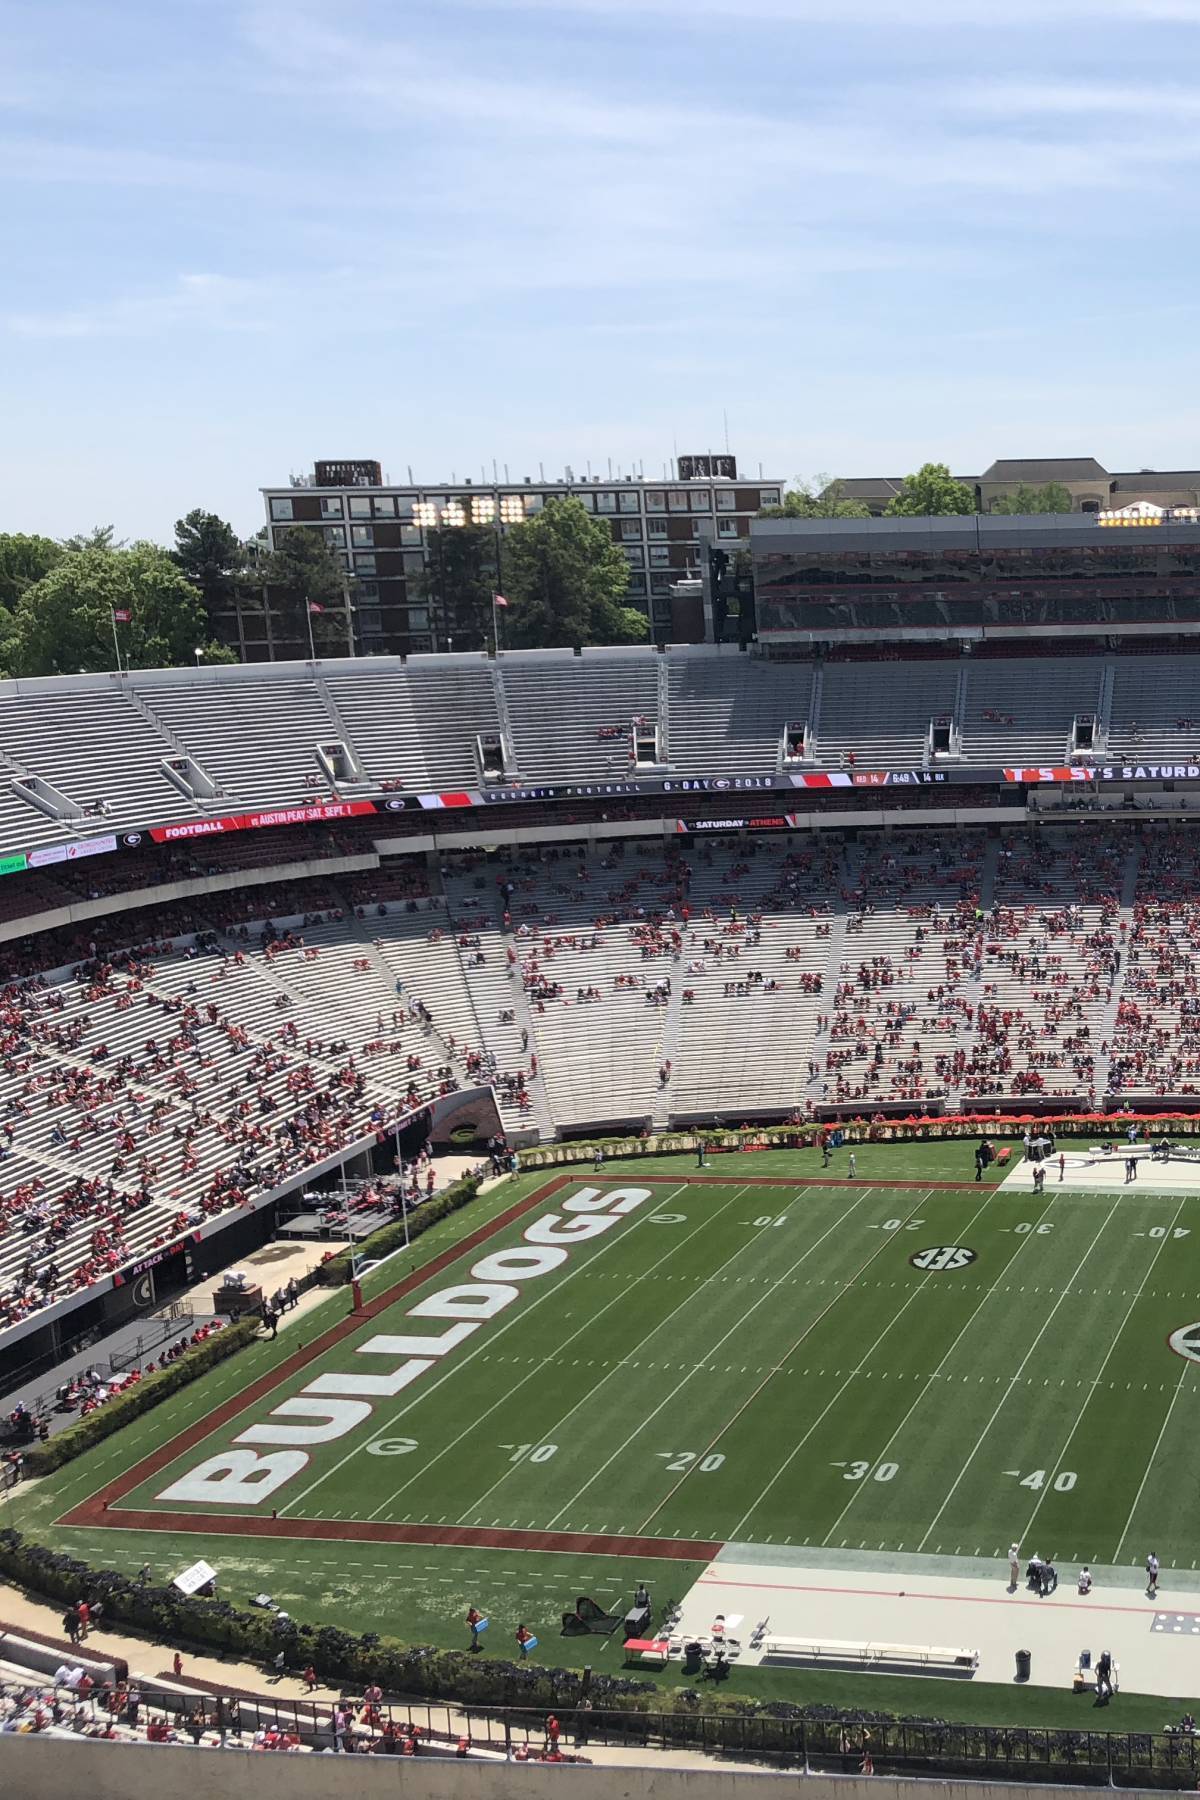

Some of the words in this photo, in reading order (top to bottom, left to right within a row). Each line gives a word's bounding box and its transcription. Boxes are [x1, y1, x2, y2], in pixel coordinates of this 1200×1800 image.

[664, 780, 711, 791] G-DAY
[735, 778, 771, 788] 2018
[856, 774, 867, 783] RED
[870, 774, 879, 783] 14
[892, 774, 910, 783] 6:49
[923, 773, 931, 782] 14
[935, 773, 945, 782] BLK
[259, 813, 287, 825] AUSTIN
[287, 811, 305, 822] PEAY
[346, 805, 351, 815] 1
[165, 821, 224, 838] FOOTBALL
[696, 820, 744, 829] SATURDAY
[749, 818, 784, 827] ATHENS
[752, 1216, 788, 1227] 10
[882, 1219, 926, 1231] 20
[1014, 1223, 1055, 1234] 30
[1149, 1227, 1191, 1238] 40
[133, 1253, 164, 1275] ATTACK
[169, 1241, 185, 1256] DAY
[912, 1247, 974, 1270] SEC
[155, 1187, 653, 1505] BULLDOGS
[509, 1443, 558, 1464] 10
[665, 1452, 727, 1472] 20
[842, 1461, 900, 1482] 30
[1019, 1470, 1077, 1493] 40
